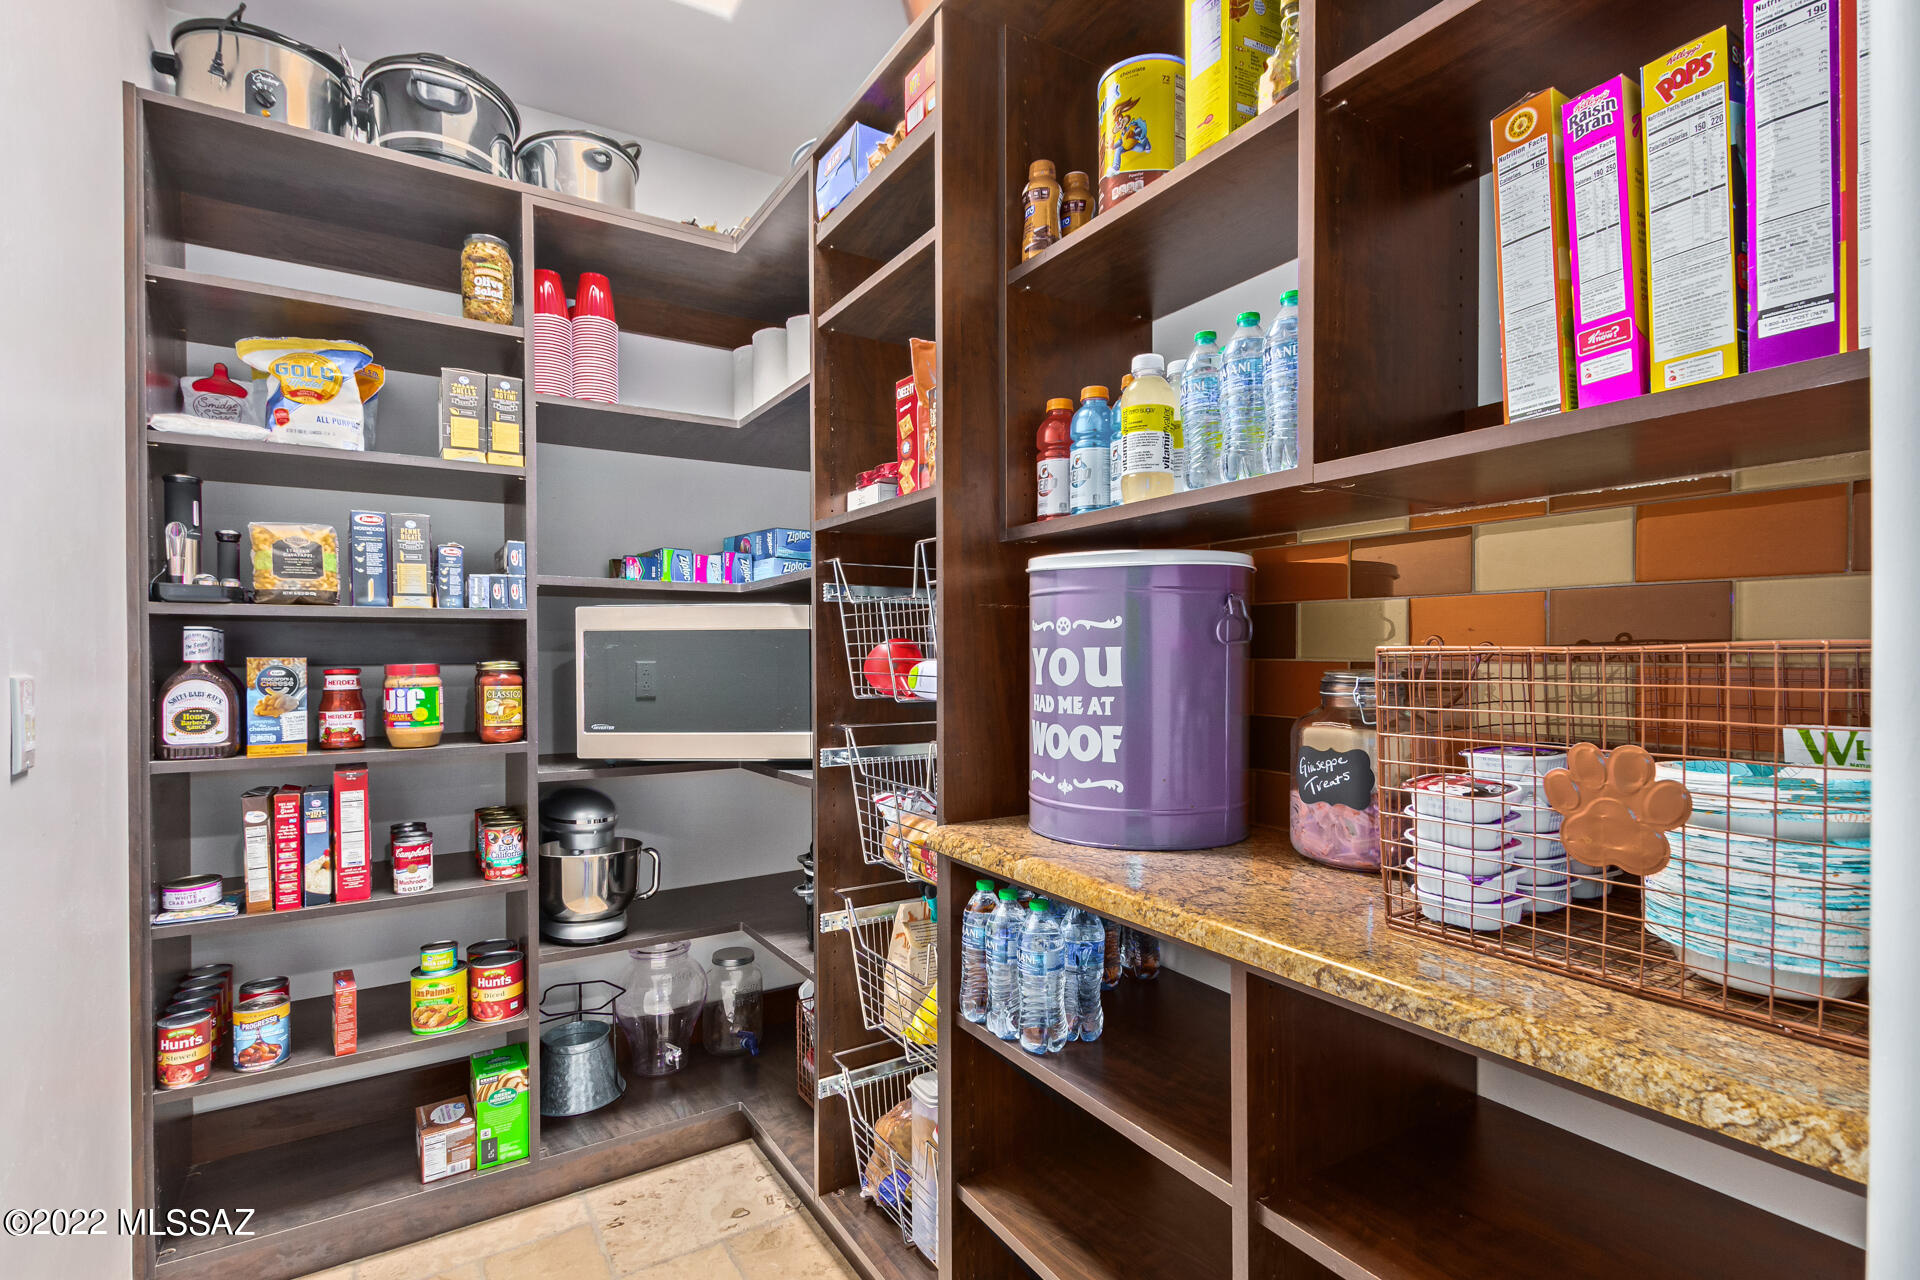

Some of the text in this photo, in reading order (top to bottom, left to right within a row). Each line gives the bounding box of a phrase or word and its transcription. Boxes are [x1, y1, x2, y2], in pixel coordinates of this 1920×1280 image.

[1755, 2, 1827, 40] Calories 190
[1120, 66, 1146, 78] chocolate
[1655, 51, 1716, 104] POPS
[1567, 98, 1617, 133] Raisin
[1694, 113, 1724, 133] 150 220
[1574, 112, 1613, 141] Bran
[1498, 135, 1547, 164] Nutrition Facts
[1573, 139, 1616, 162] Nutrition Facts
[1531, 157, 1546, 170] 160
[1593, 168, 1604, 179] 190
[1605, 162, 1617, 173] 250
[473, 275, 504, 291] Olive
[474, 286, 504, 300] Salad
[275, 362, 335, 382] GOLD
[452, 386, 477, 397] SHELLS
[494, 391, 517, 402] ROTINI
[198, 395, 239, 412] Smidge
[316, 415, 330, 424] ALL
[400, 527, 421, 535] PENNE
[786, 530, 811, 543] Ziploc
[679, 555, 691, 581] Ziploc
[740, 558, 751, 583] Ziploc
[783, 561, 808, 574] Ziploc
[1031, 646, 1124, 688] YOU
[168, 692, 187, 705] SWEET
[1033, 693, 1115, 716] HAD ME AT
[182, 713, 211, 722] Honey
[1031, 719, 1124, 763] WOOF
[1299, 756, 1349, 778] Giuseppe
[1303, 770, 1351, 796] Treats
[498, 843, 518, 852] Early
[399, 878, 428, 886] Mushroom
[187, 896, 207, 905] MEAT
[477, 975, 512, 988] Hunt's
[425, 986, 456, 998] Palmas
[484, 990, 505, 999] Diced
[241, 1015, 278, 1031] PROGRESSO
[160, 1034, 203, 1050] Hunt's
[166, 1051, 197, 1062] Stewed
